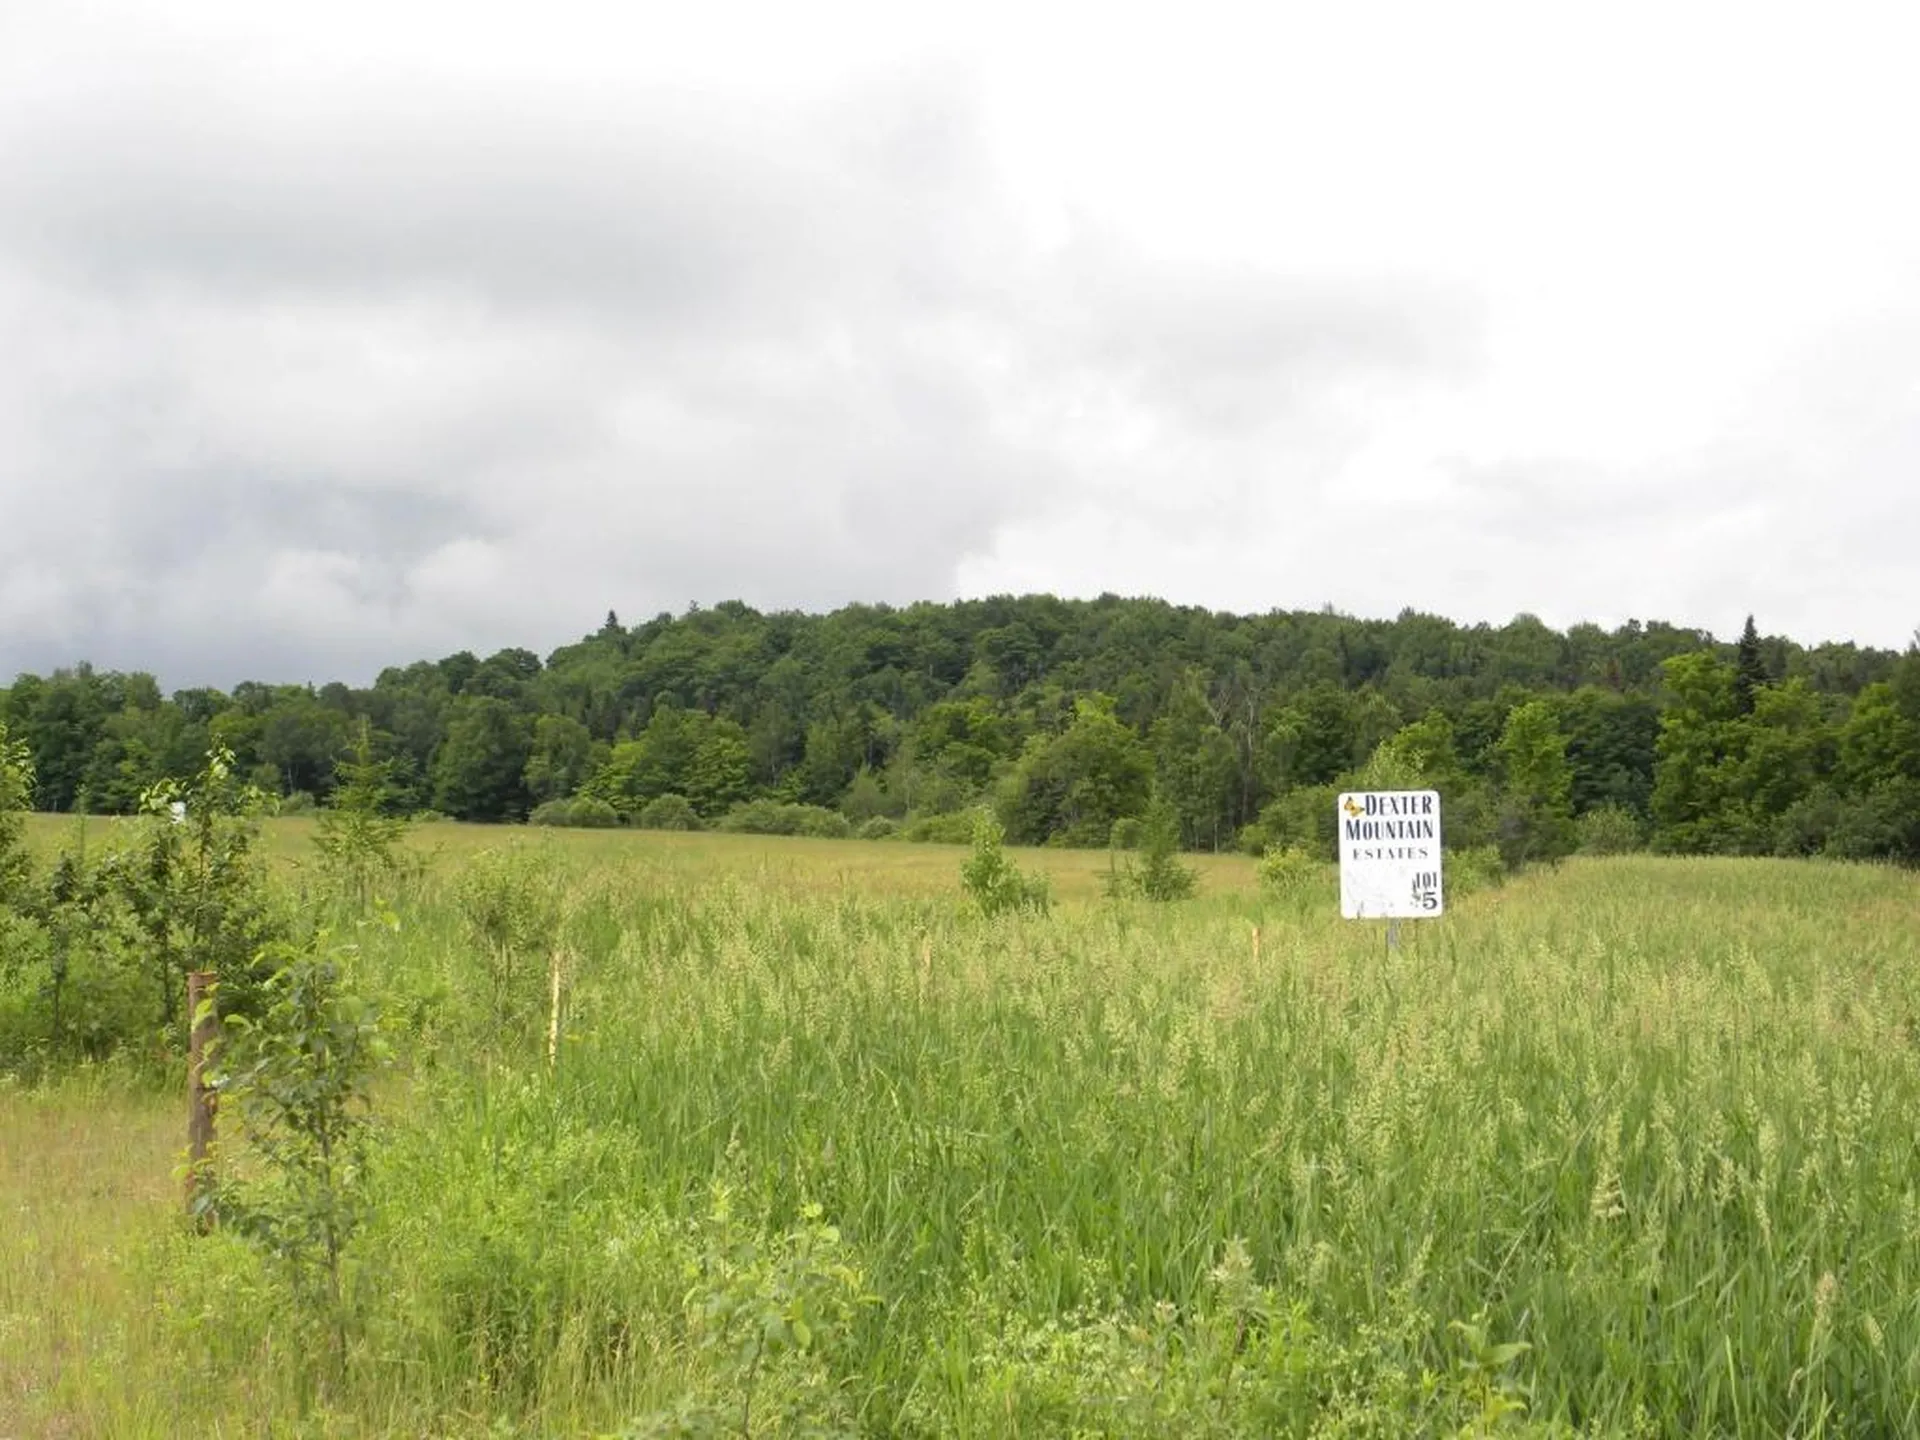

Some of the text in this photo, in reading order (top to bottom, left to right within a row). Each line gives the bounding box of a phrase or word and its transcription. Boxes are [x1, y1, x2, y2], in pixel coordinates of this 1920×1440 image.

[1365, 795, 1432, 816] DEXTER
[1346, 819, 1433, 840] MOUNTAIN
[1353, 847, 1428, 859] ESTATES
